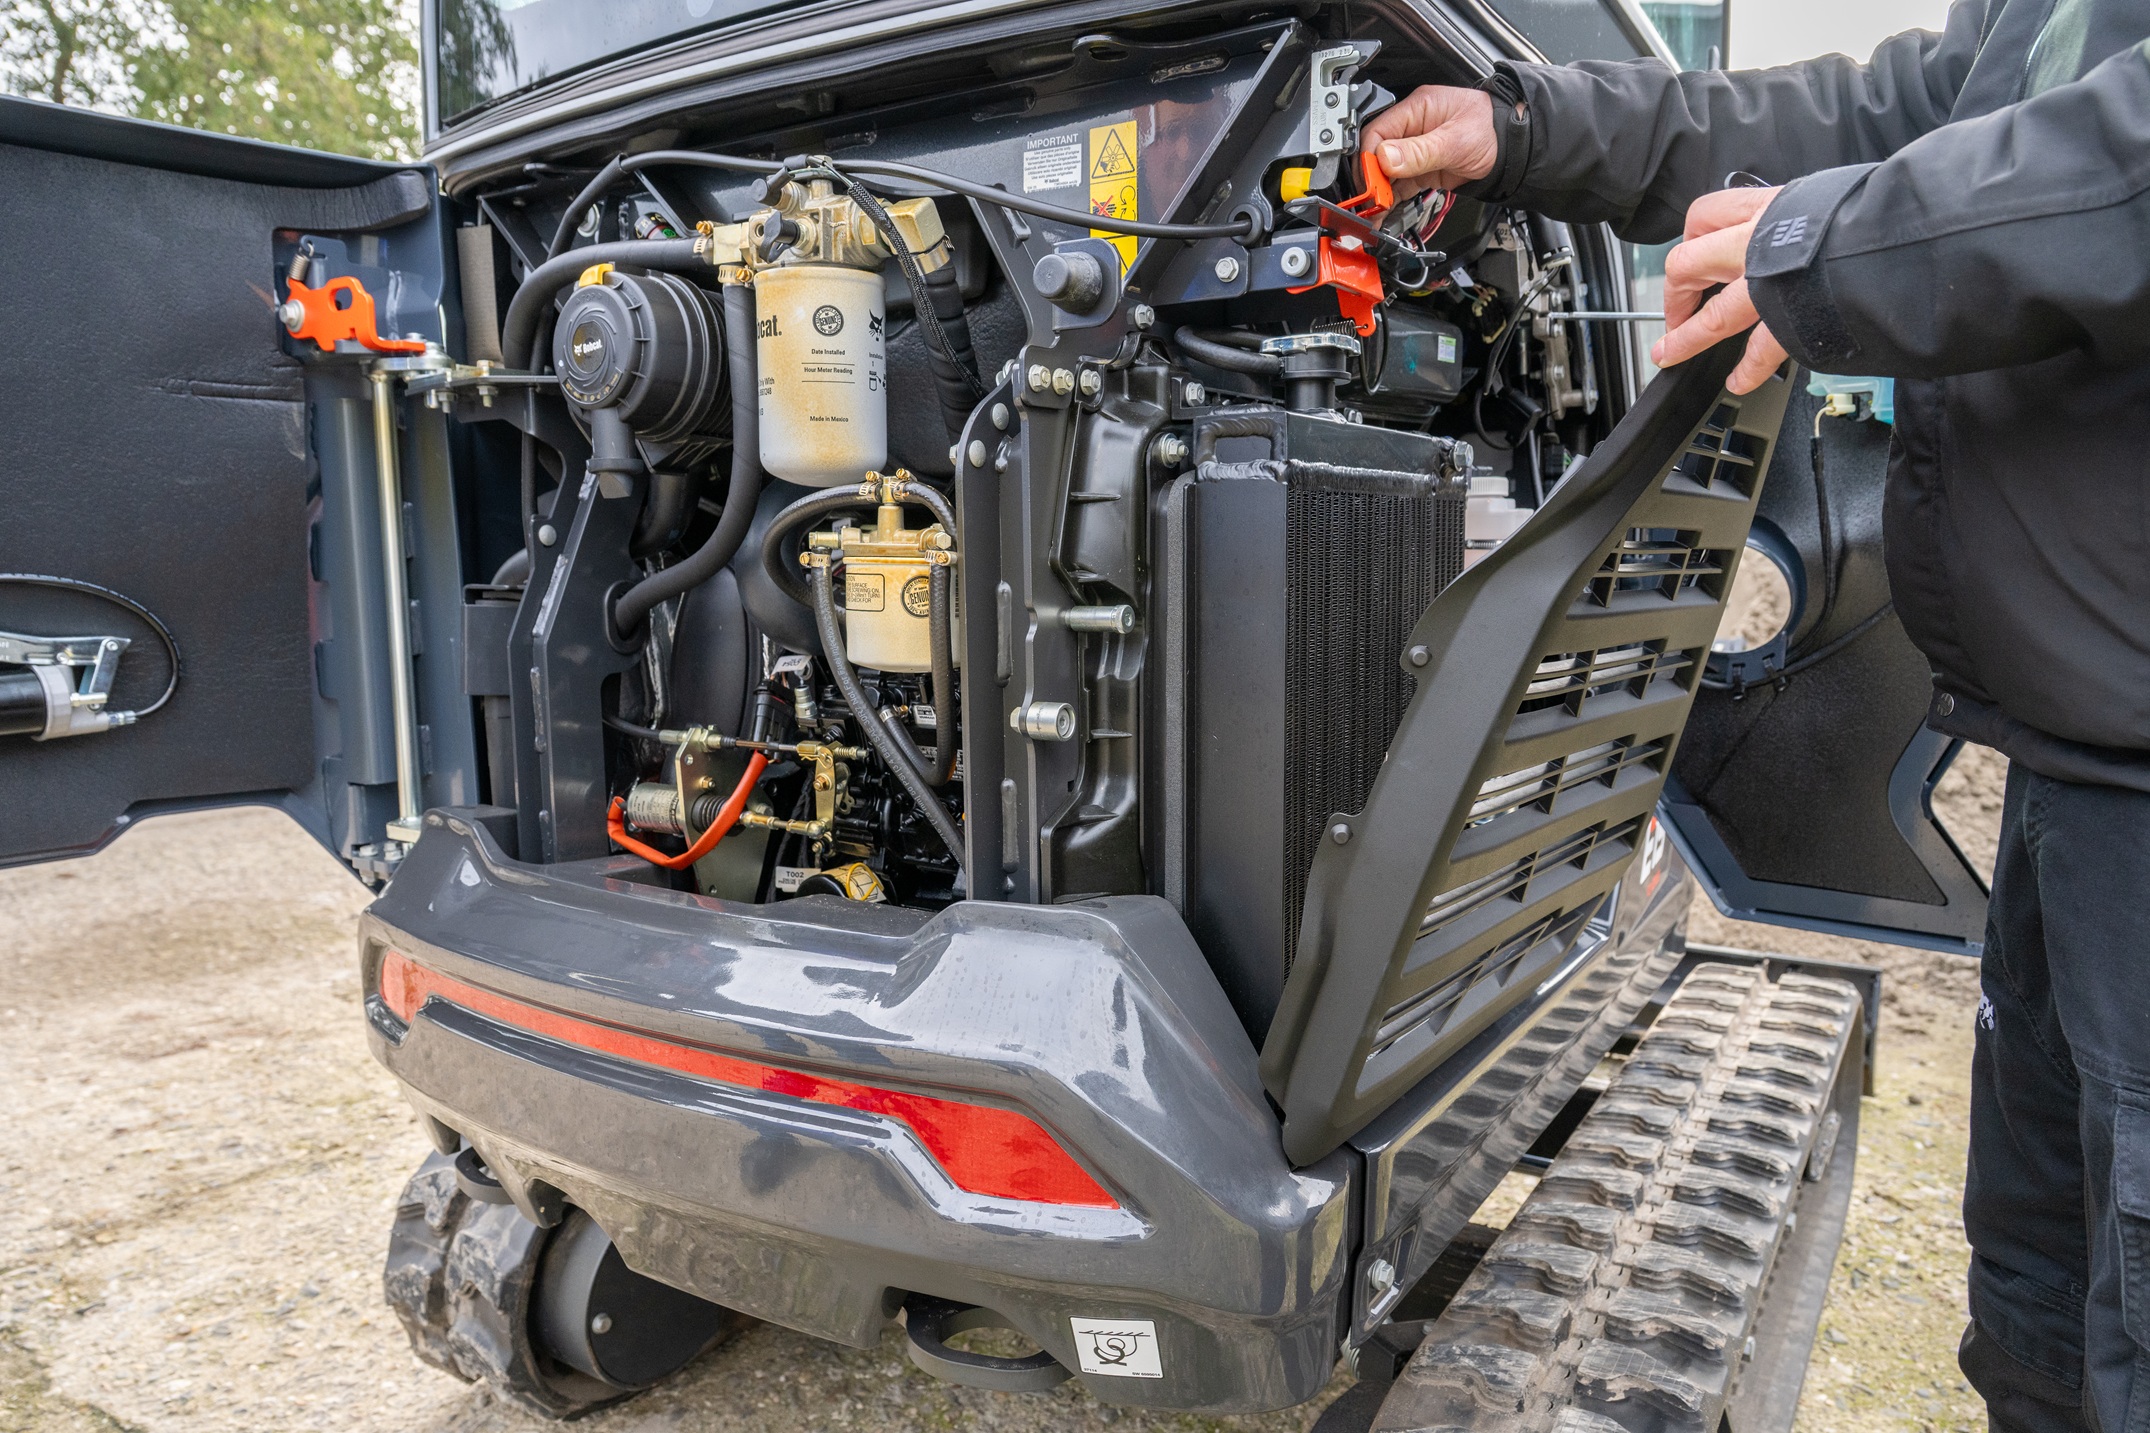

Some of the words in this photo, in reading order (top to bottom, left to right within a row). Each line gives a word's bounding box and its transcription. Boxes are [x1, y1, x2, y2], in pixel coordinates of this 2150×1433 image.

[1027, 133, 1078, 150] IMPORTANT
[909, 590, 929, 604] GENUIN
[833, 656, 845, 675] Fuel
[840, 674, 852, 690] For
[846, 690, 860, 706] Not
[866, 725, 881, 742] SAE
[897, 772, 909, 786] PSI
